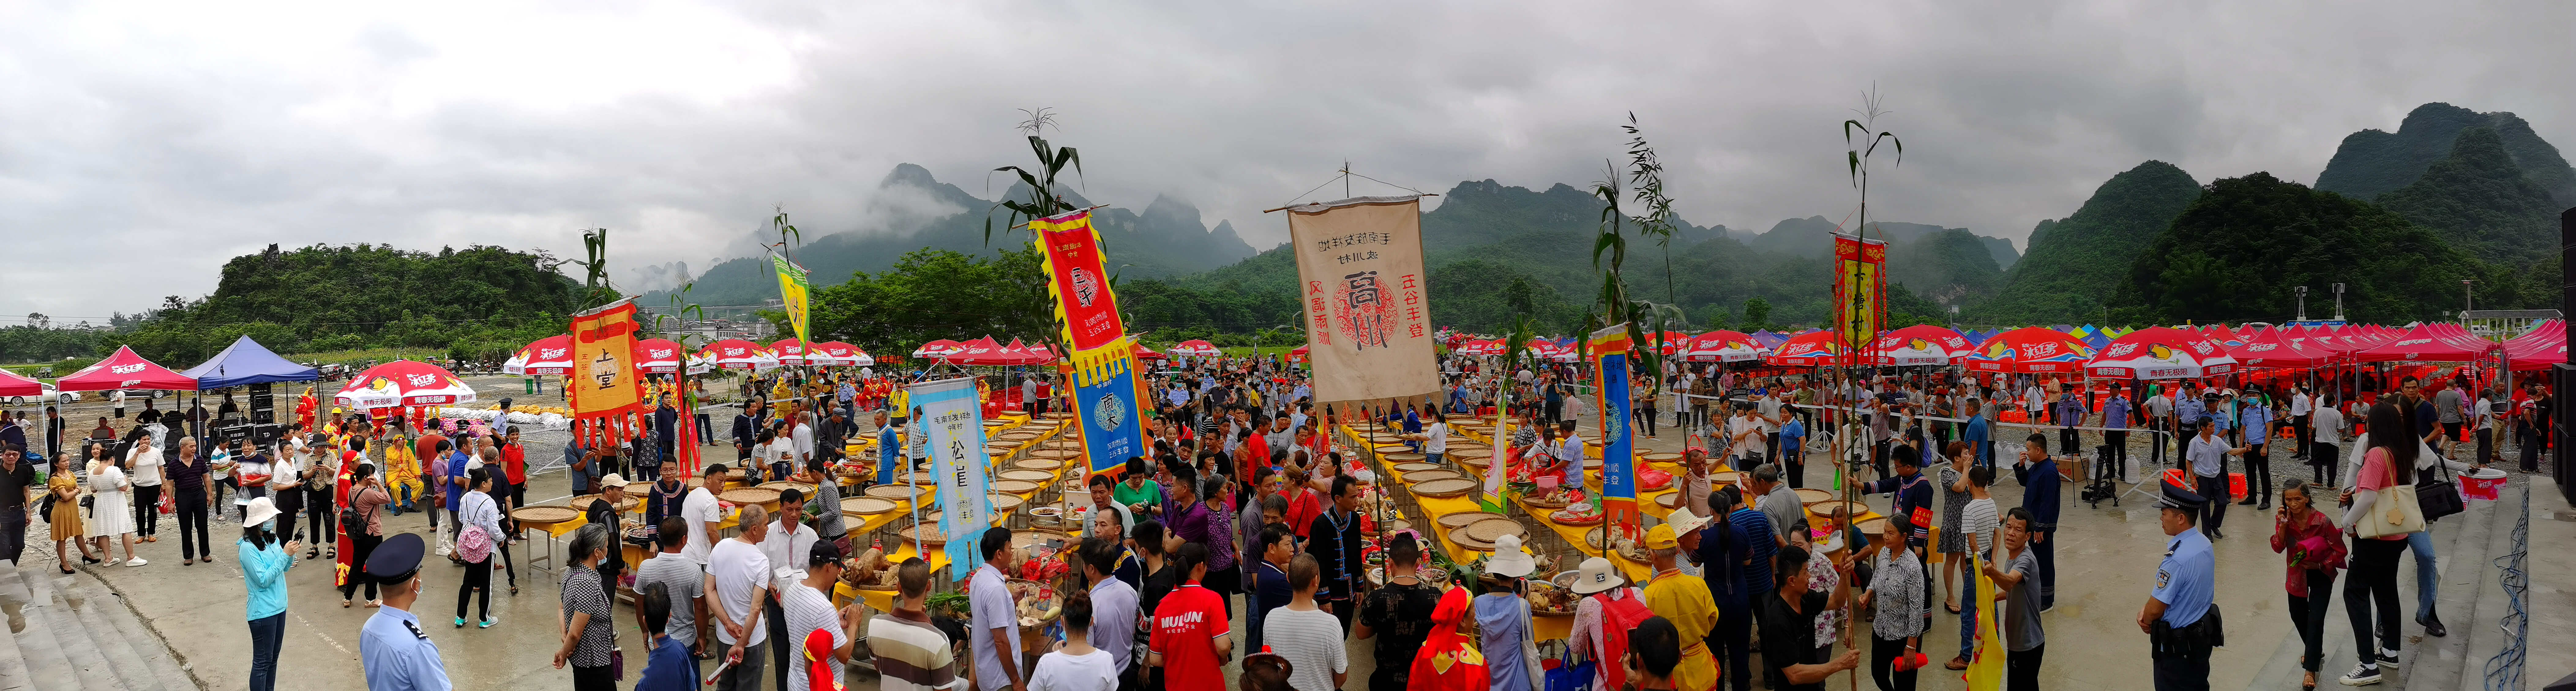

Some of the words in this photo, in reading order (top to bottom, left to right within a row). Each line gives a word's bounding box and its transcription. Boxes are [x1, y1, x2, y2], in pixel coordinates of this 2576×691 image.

[540, 348, 566, 360] 冰红茶
[650, 349, 673, 359] 冰红茶
[725, 347, 745, 357] 冰红茶
[1786, 342, 1816, 355] 冰红茶
[2023, 342, 2057, 360] 冰红茶
[2106, 342, 2139, 357] 冰红茶
[596, 348, 616, 390] 上堂
[2150, 368, 2188, 377] 青春无极限
[2210, 365, 2231, 374] 青春无极限
[409, 373, 436, 387] 冰红茶
[363, 398, 392, 406] 青春无极限
[1100, 392, 1119, 432] 南木
[1161, 611, 1203, 629] MULUN
